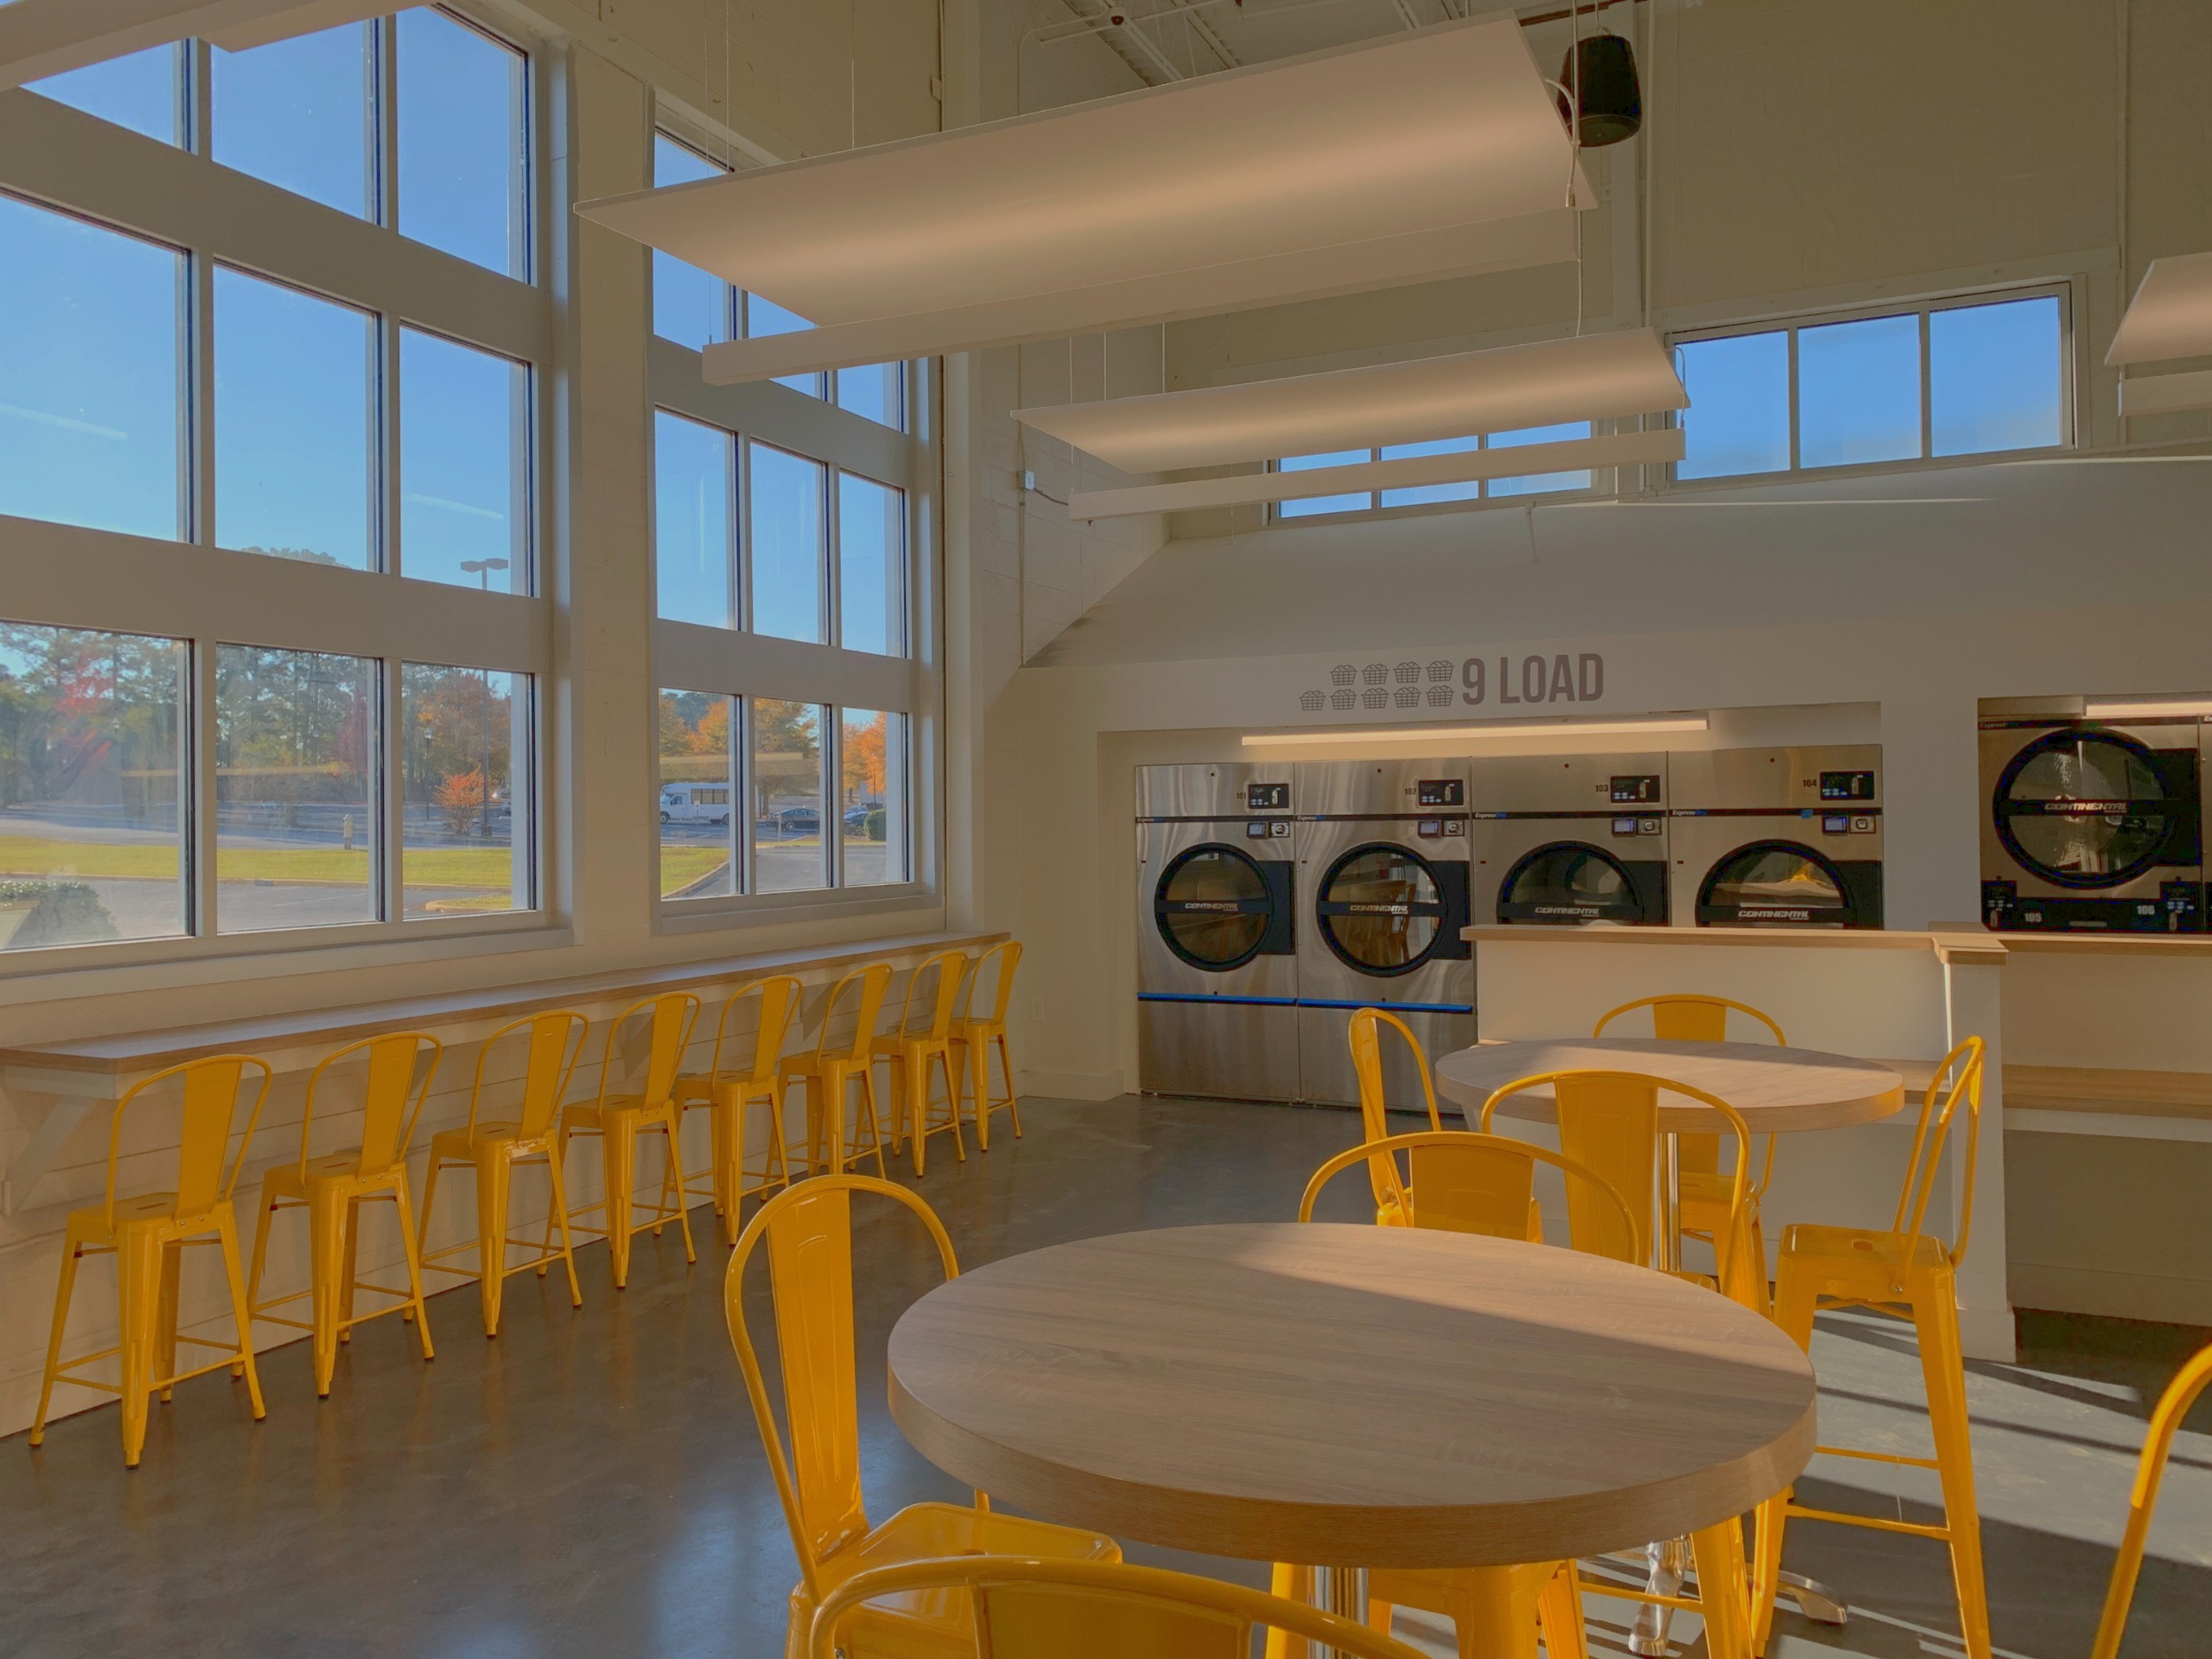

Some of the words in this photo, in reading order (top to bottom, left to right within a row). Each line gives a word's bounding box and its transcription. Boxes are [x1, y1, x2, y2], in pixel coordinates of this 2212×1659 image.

[1463, 657, 1486, 705] 9
[1500, 653, 1604, 703] LOAD
[1802, 779, 1817, 787] 104
[1534, 906, 1600, 915] CONTINENTAL
[2136, 904, 2155, 915] 106
[2024, 912, 2042, 922] 105
